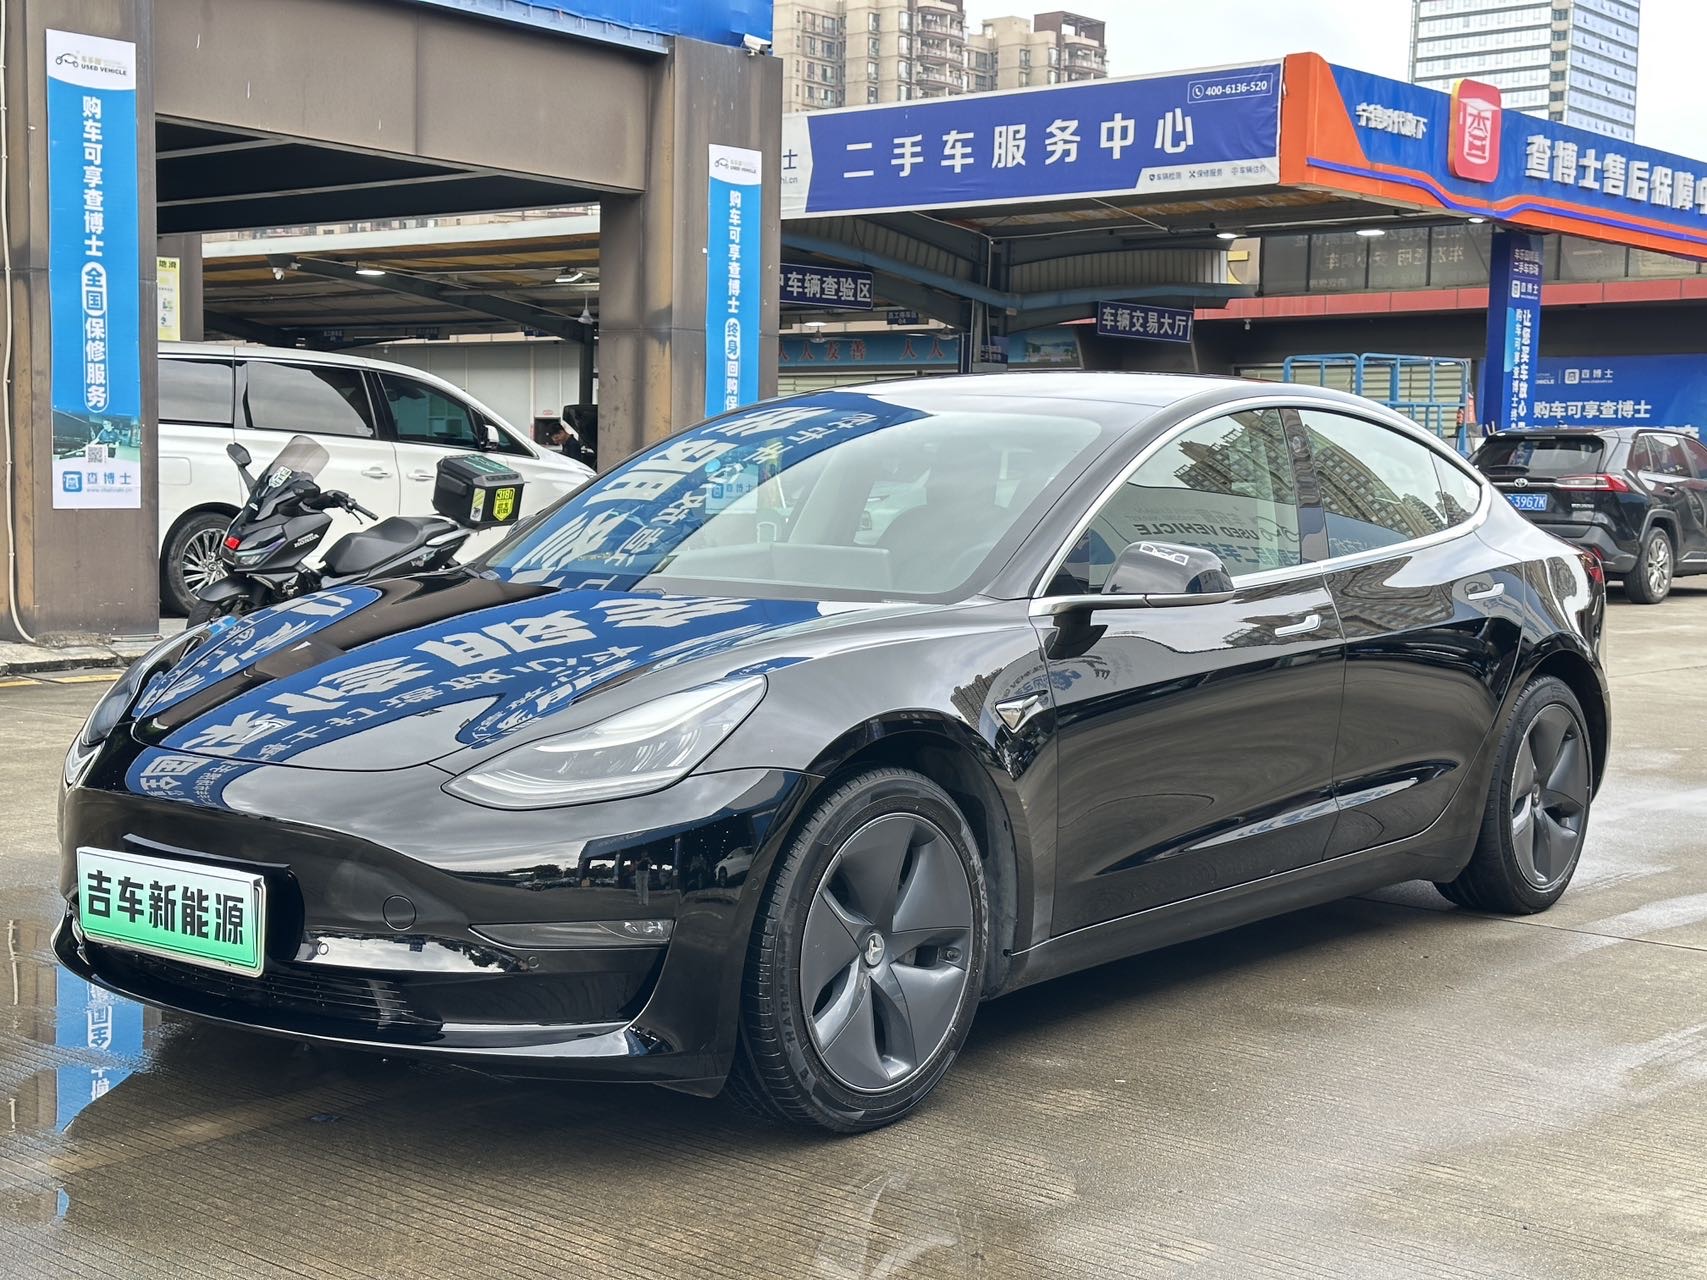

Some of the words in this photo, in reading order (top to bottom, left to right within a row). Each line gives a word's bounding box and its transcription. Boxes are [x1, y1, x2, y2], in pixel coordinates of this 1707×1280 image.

[81, 63, 99, 71] USED
[99, 67, 127, 76] VEHICLE
[1205, 81, 1268, 96] 400-6136-520
[82, 96, 103, 256] 购车可享查博士
[843, 108, 1194, 179] 二手车服务中心
[728, 189, 742, 314] 购车可享查博士
[85, 267, 107, 408] 全国保修服务
[1102, 306, 1188, 337] 车辆交易大厅
[1533, 400, 1652, 419] 购车可享查博士
[87, 869, 244, 945] 吉车新能源
